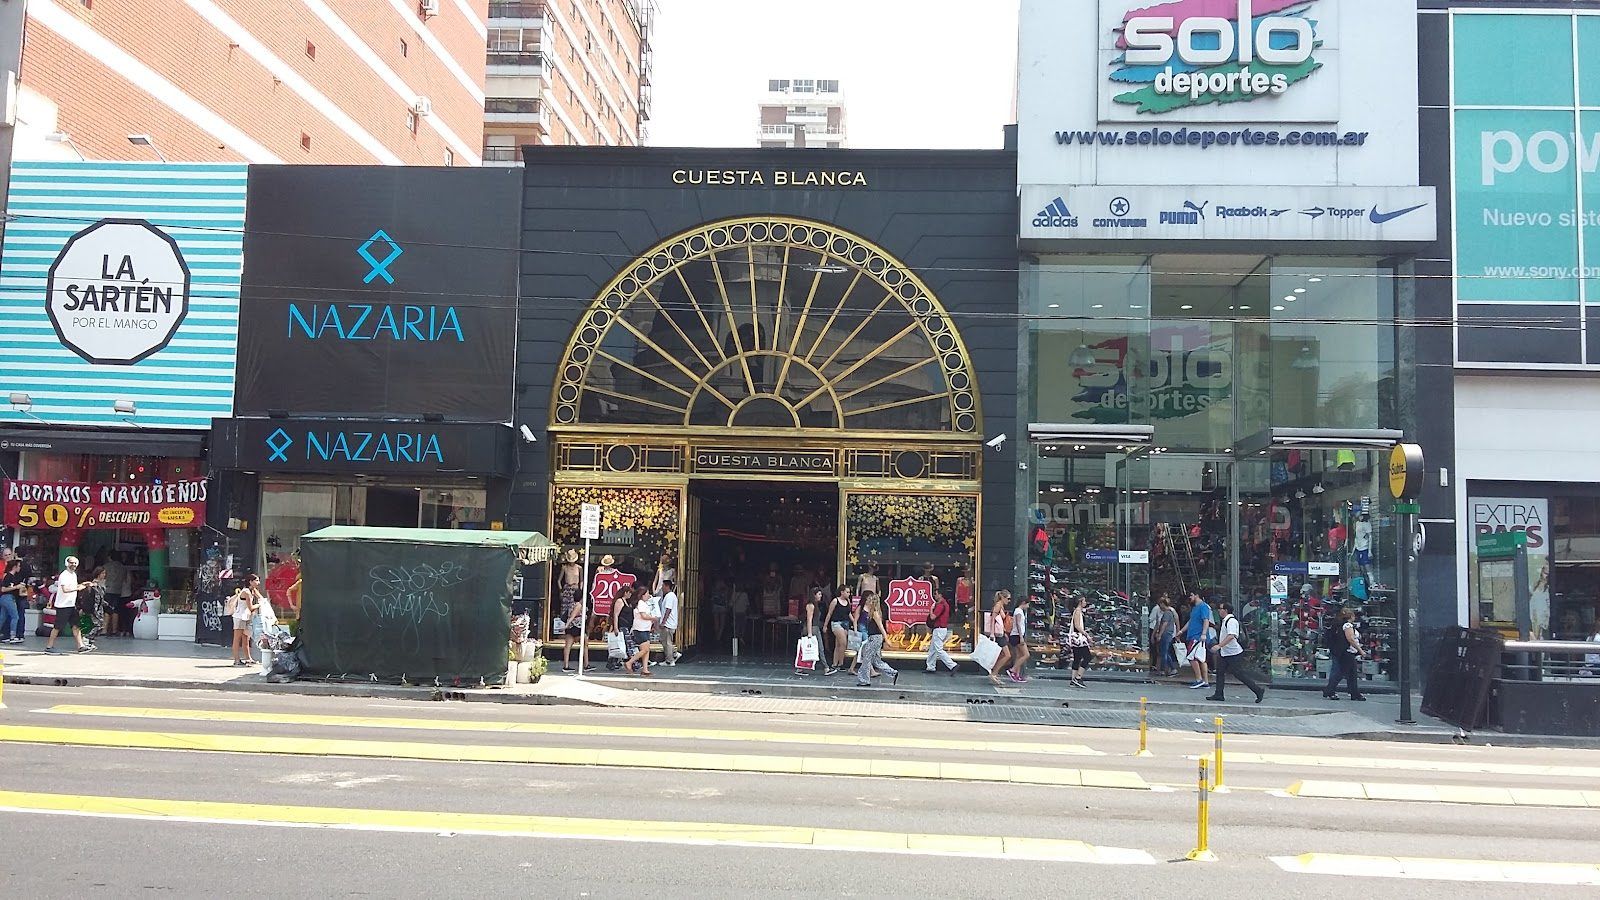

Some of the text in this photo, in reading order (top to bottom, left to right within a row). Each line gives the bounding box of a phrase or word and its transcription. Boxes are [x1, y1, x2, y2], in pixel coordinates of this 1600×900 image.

[1124, 0, 1313, 66] solo
[1155, 66, 1288, 100] deportes
[1055, 127, 1369, 149] www.solodeportes.com.ar
[672, 170, 868, 186] CUESTA BLANCA
[1032, 215, 1077, 228] adidas
[1159, 211, 1198, 225] PUMA
[1216, 205, 1267, 219] Reebok
[1326, 207, 1365, 219] Topper
[1483, 208, 1552, 226] Nuevo
[101, 254, 136, 280] LA
[63, 278, 172, 313] SARTÉN
[73, 317, 158, 330] POR EL MANGO
[288, 304, 465, 342] NAZARIA
[1101, 389, 1210, 411] deortes
[306, 431, 444, 463] NAZARIA
[697, 455, 832, 468] CUESTA BLANCA
[9, 479, 208, 504] ADORNOS NAVIDEÑOS
[18, 504, 150, 527] 50% DESCUENTO
[1475, 504, 1542, 524] EXTRA
